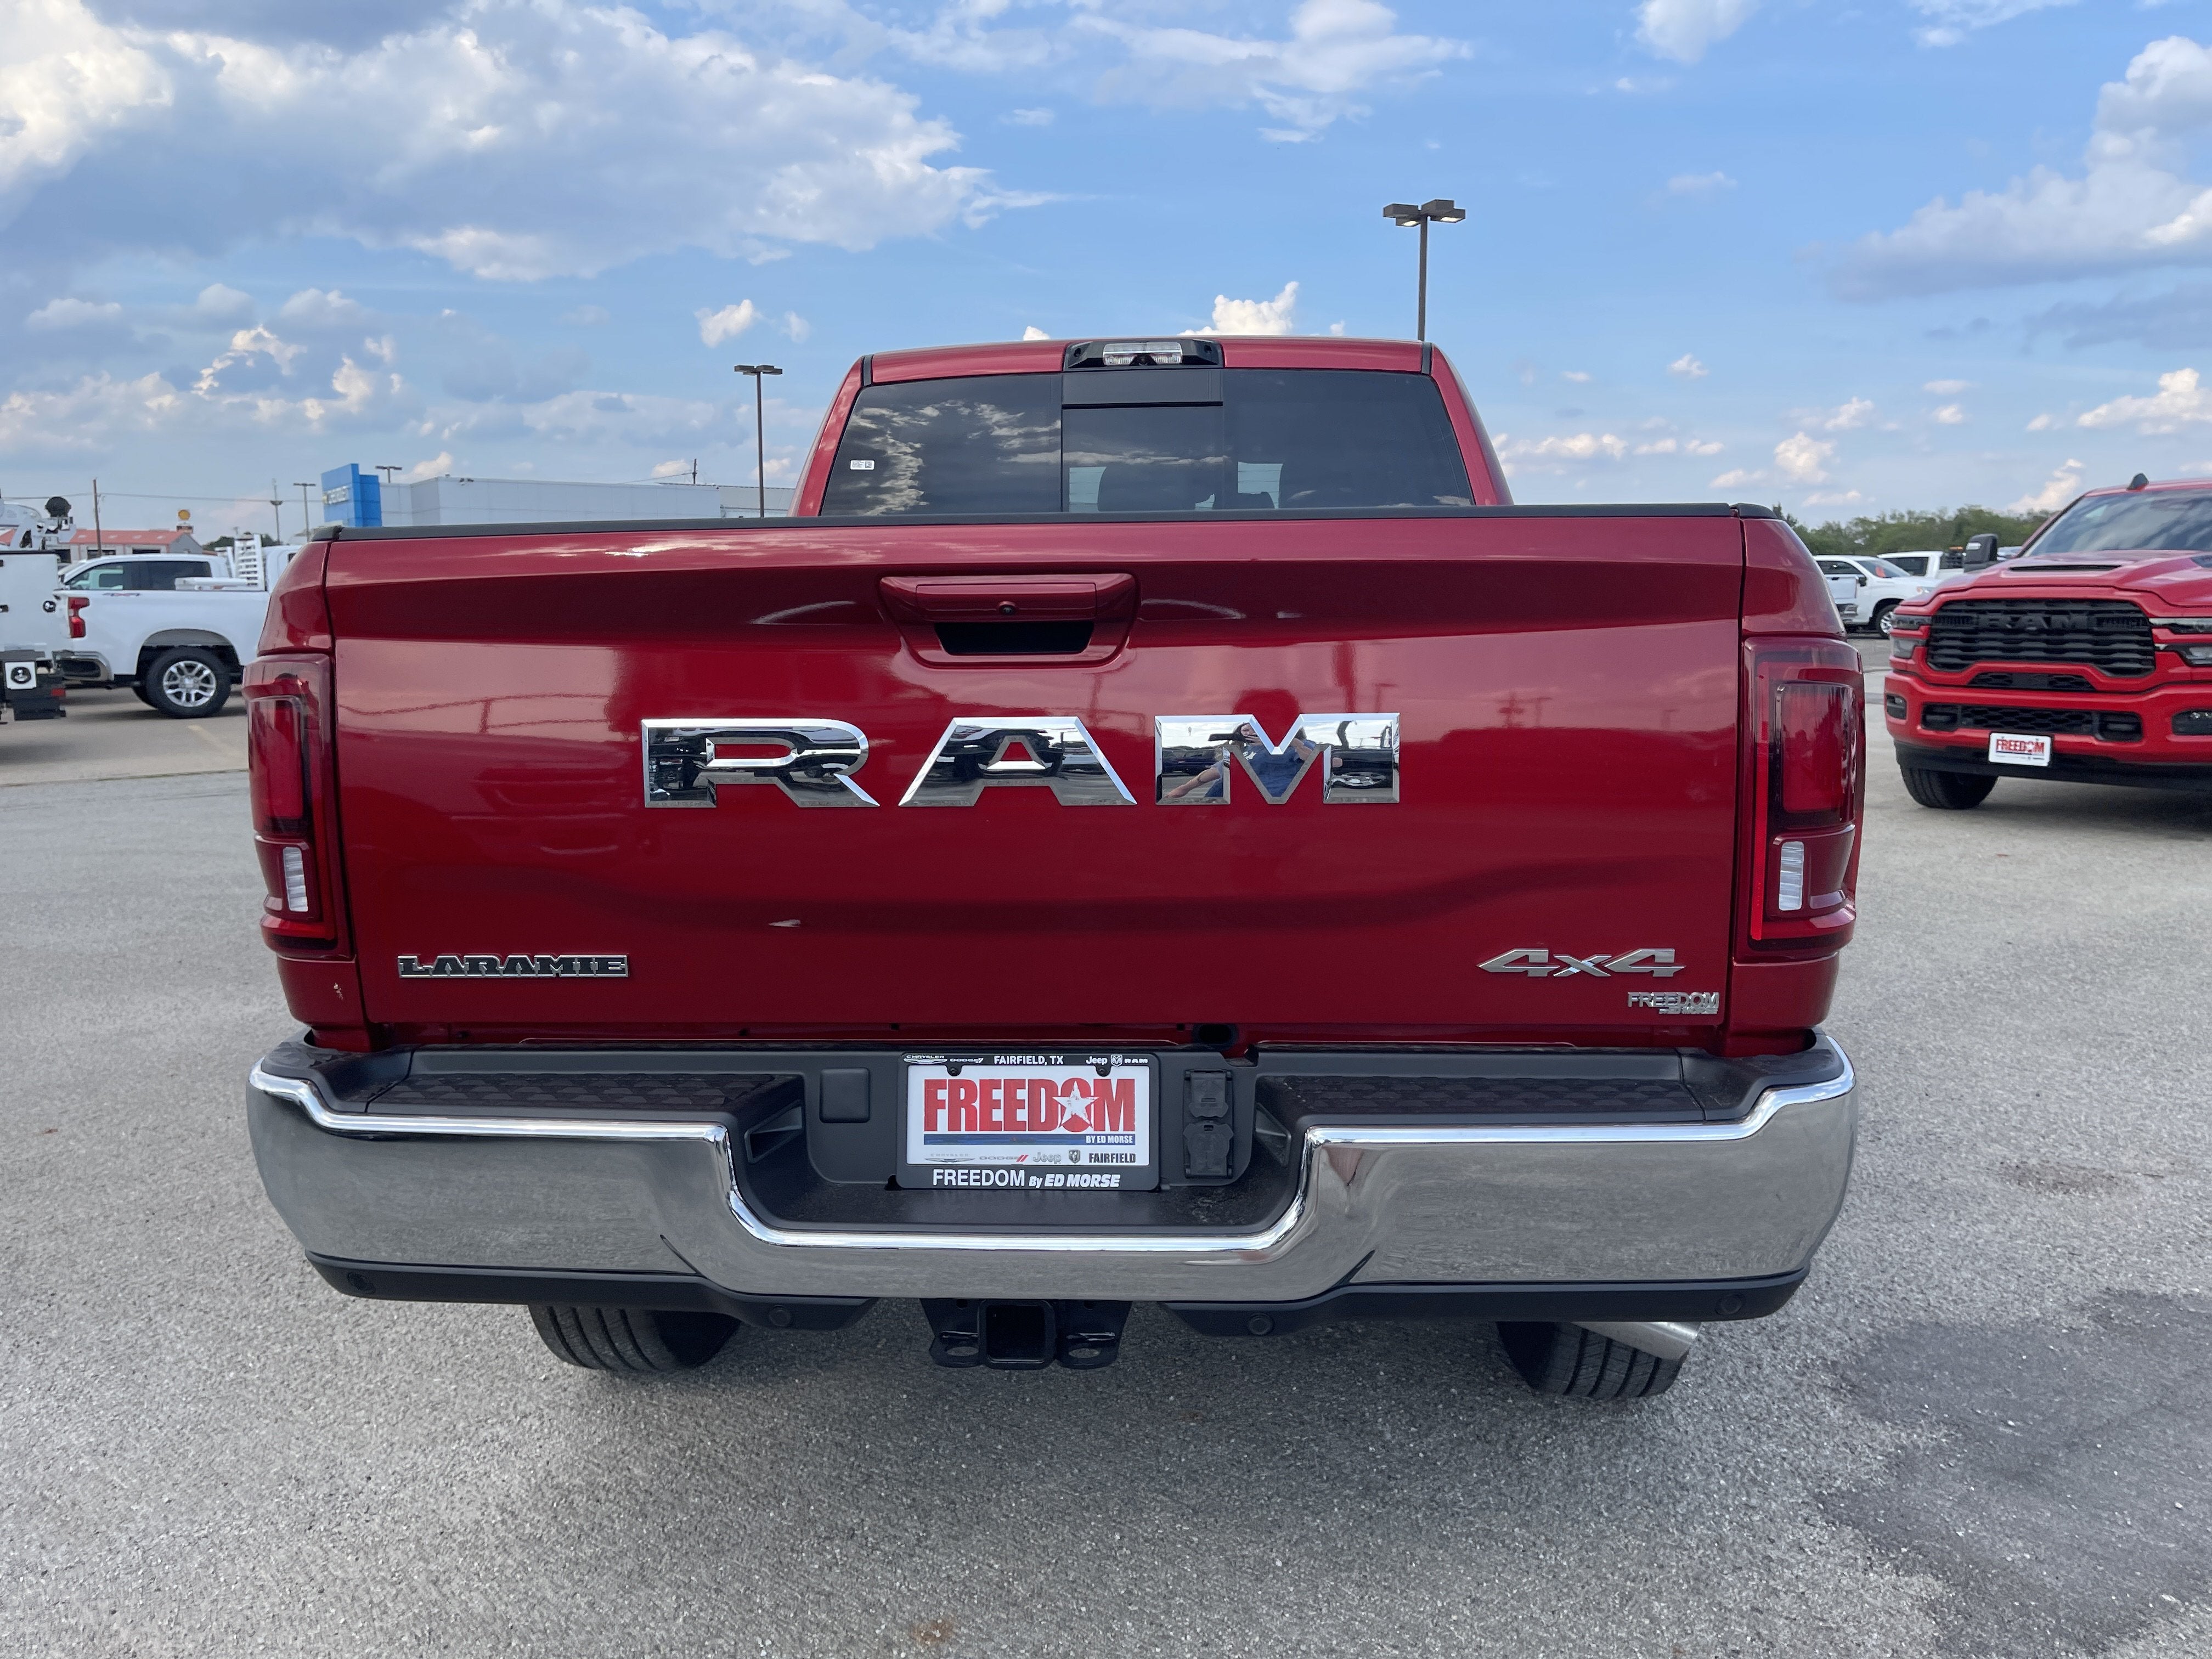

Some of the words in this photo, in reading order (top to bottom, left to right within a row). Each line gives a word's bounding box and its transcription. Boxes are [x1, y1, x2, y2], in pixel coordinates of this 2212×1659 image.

[1996, 739, 2045, 753] FREEDOM
[641, 712, 1401, 809] RAM
[397, 955, 629, 978] LARAMIE
[1628, 991, 1720, 1008] FREEDOM
[994, 1056, 1047, 1066] FAIRFIELD,
[1049, 1056, 1064, 1064] TX
[1086, 1056, 1108, 1065] Jeep
[924, 1078, 1136, 1132] FREEDOM
[1086, 1135, 1096, 1143] BY
[1097, 1135, 1106, 1143] ED
[1107, 1135, 1133, 1143] MORSE
[1033, 1152, 1062, 1164] Jeep
[1089, 1153, 1136, 1163] FAIRFIELD
[932, 1169, 1025, 1187] FREEDOM
[1028, 1176, 1042, 1188] By
[1044, 1173, 1065, 1187] ED
[1066, 1173, 1121, 1188] MORSE
